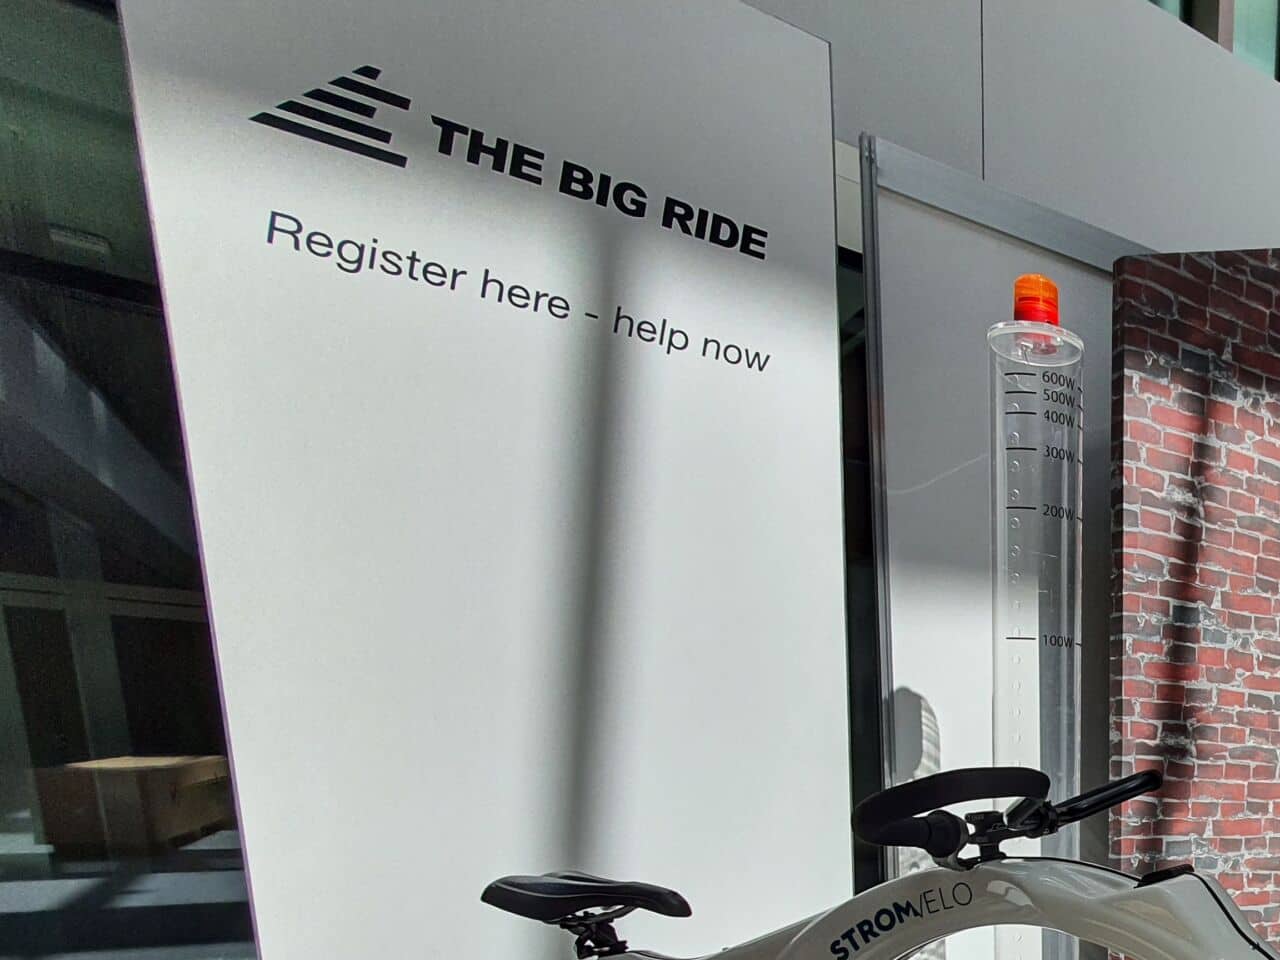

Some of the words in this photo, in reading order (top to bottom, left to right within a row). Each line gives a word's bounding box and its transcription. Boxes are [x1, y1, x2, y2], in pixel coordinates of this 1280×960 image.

[430, 114, 545, 186] THE
[558, 159, 648, 218] BIG
[660, 196, 768, 261] RIDE
[266, 210, 468, 291] Register
[480, 268, 571, 320] here
[612, 306, 690, 355] help
[701, 334, 771, 373] now
[1042, 371, 1075, 391] 600W
[1043, 388, 1075, 408] 500W
[1043, 409, 1075, 428] 400W
[1043, 445, 1075, 463] 300W
[1042, 504, 1074, 521] 200W
[1042, 634, 1073, 648] 100W
